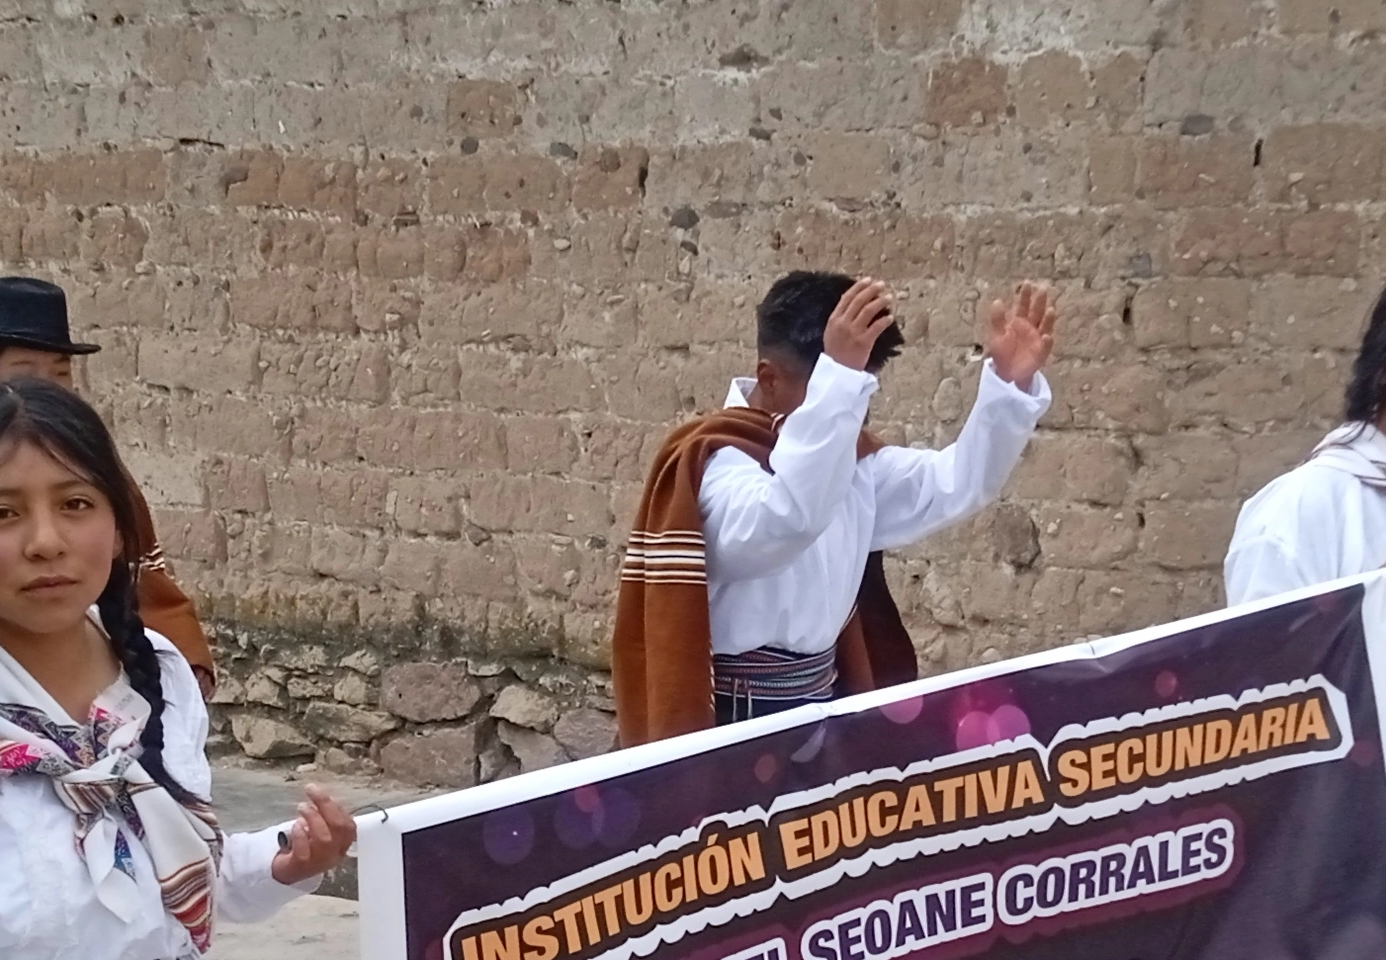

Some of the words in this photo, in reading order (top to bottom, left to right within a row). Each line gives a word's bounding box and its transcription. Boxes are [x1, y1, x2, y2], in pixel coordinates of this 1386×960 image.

[779, 758, 1044, 870] EDUCATIVA
[1057, 698, 1331, 798] SECUNDARIA
[1005, 827, 1228, 918] CORRALES
